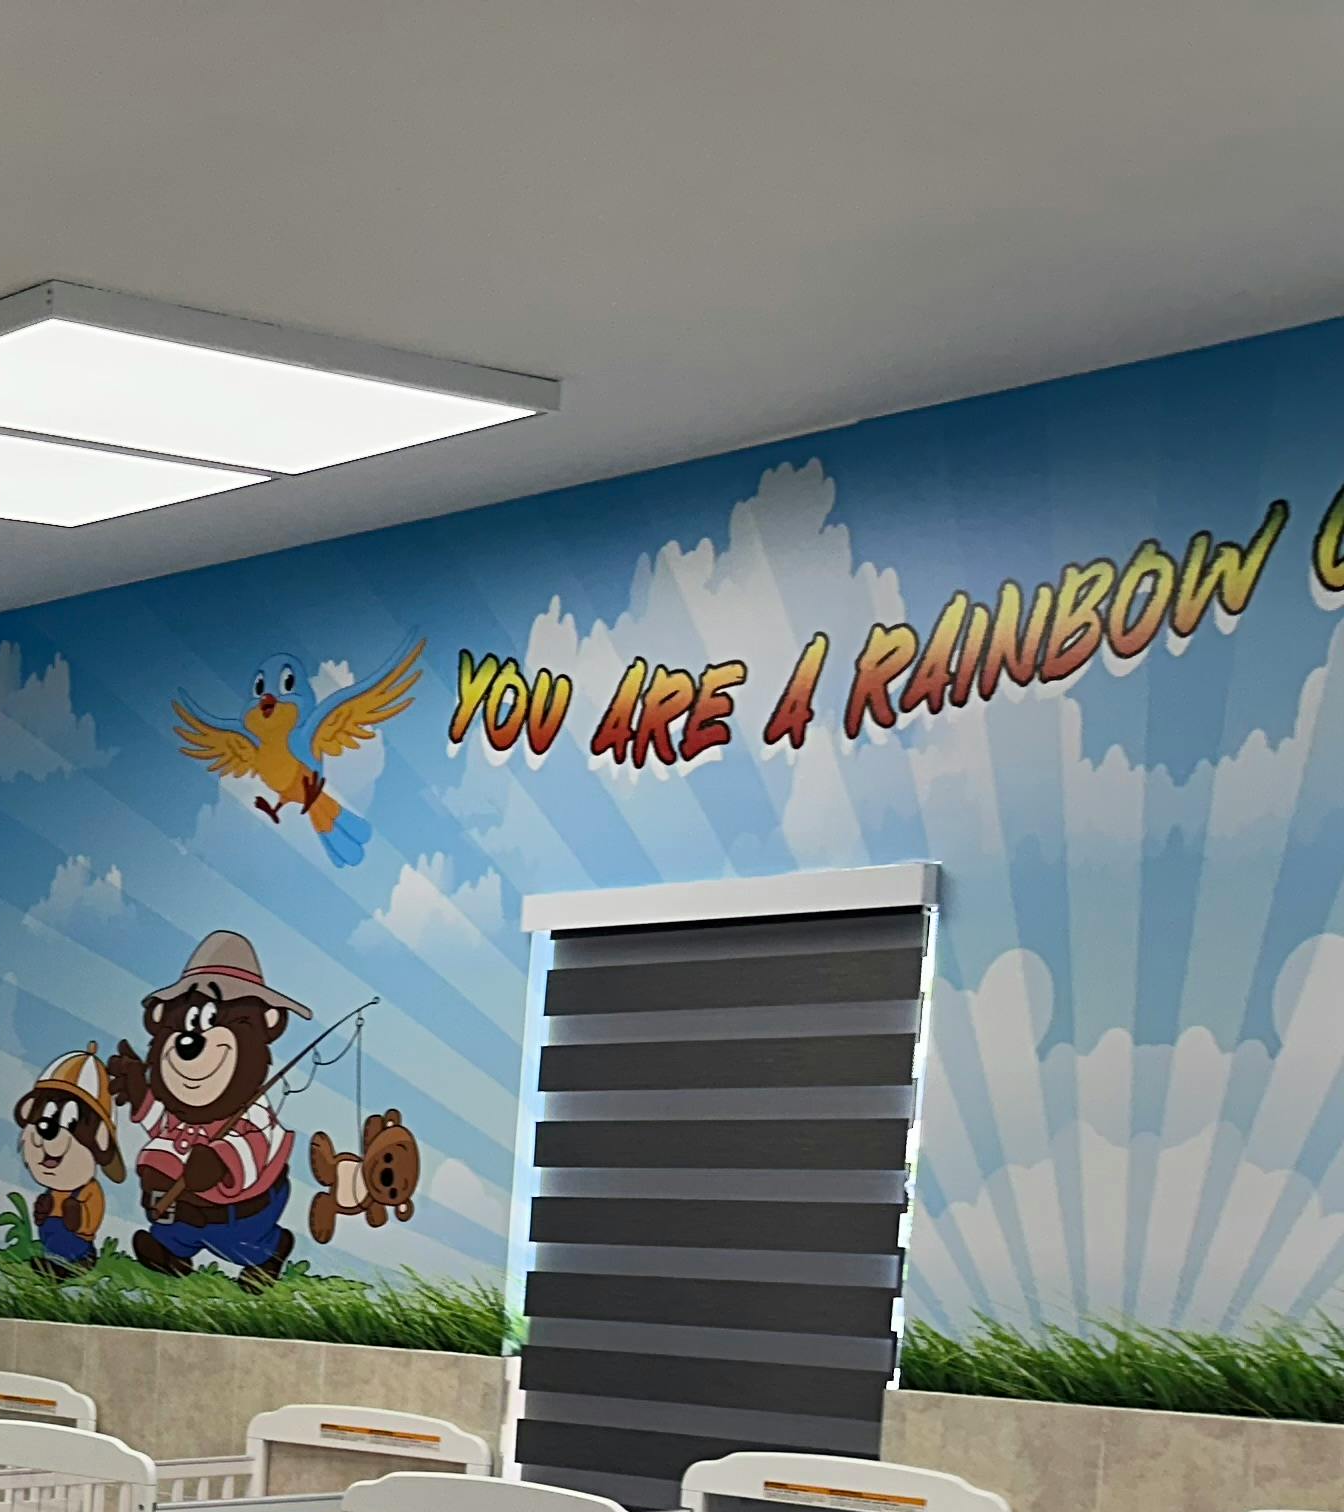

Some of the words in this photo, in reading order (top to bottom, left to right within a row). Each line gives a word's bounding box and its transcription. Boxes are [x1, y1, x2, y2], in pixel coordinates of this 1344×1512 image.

[448, 648, 573, 754] YOU
[591, 657, 748, 768] ARE
[764, 631, 830, 749] A
[844, 499, 1289, 740] RAINBOW
